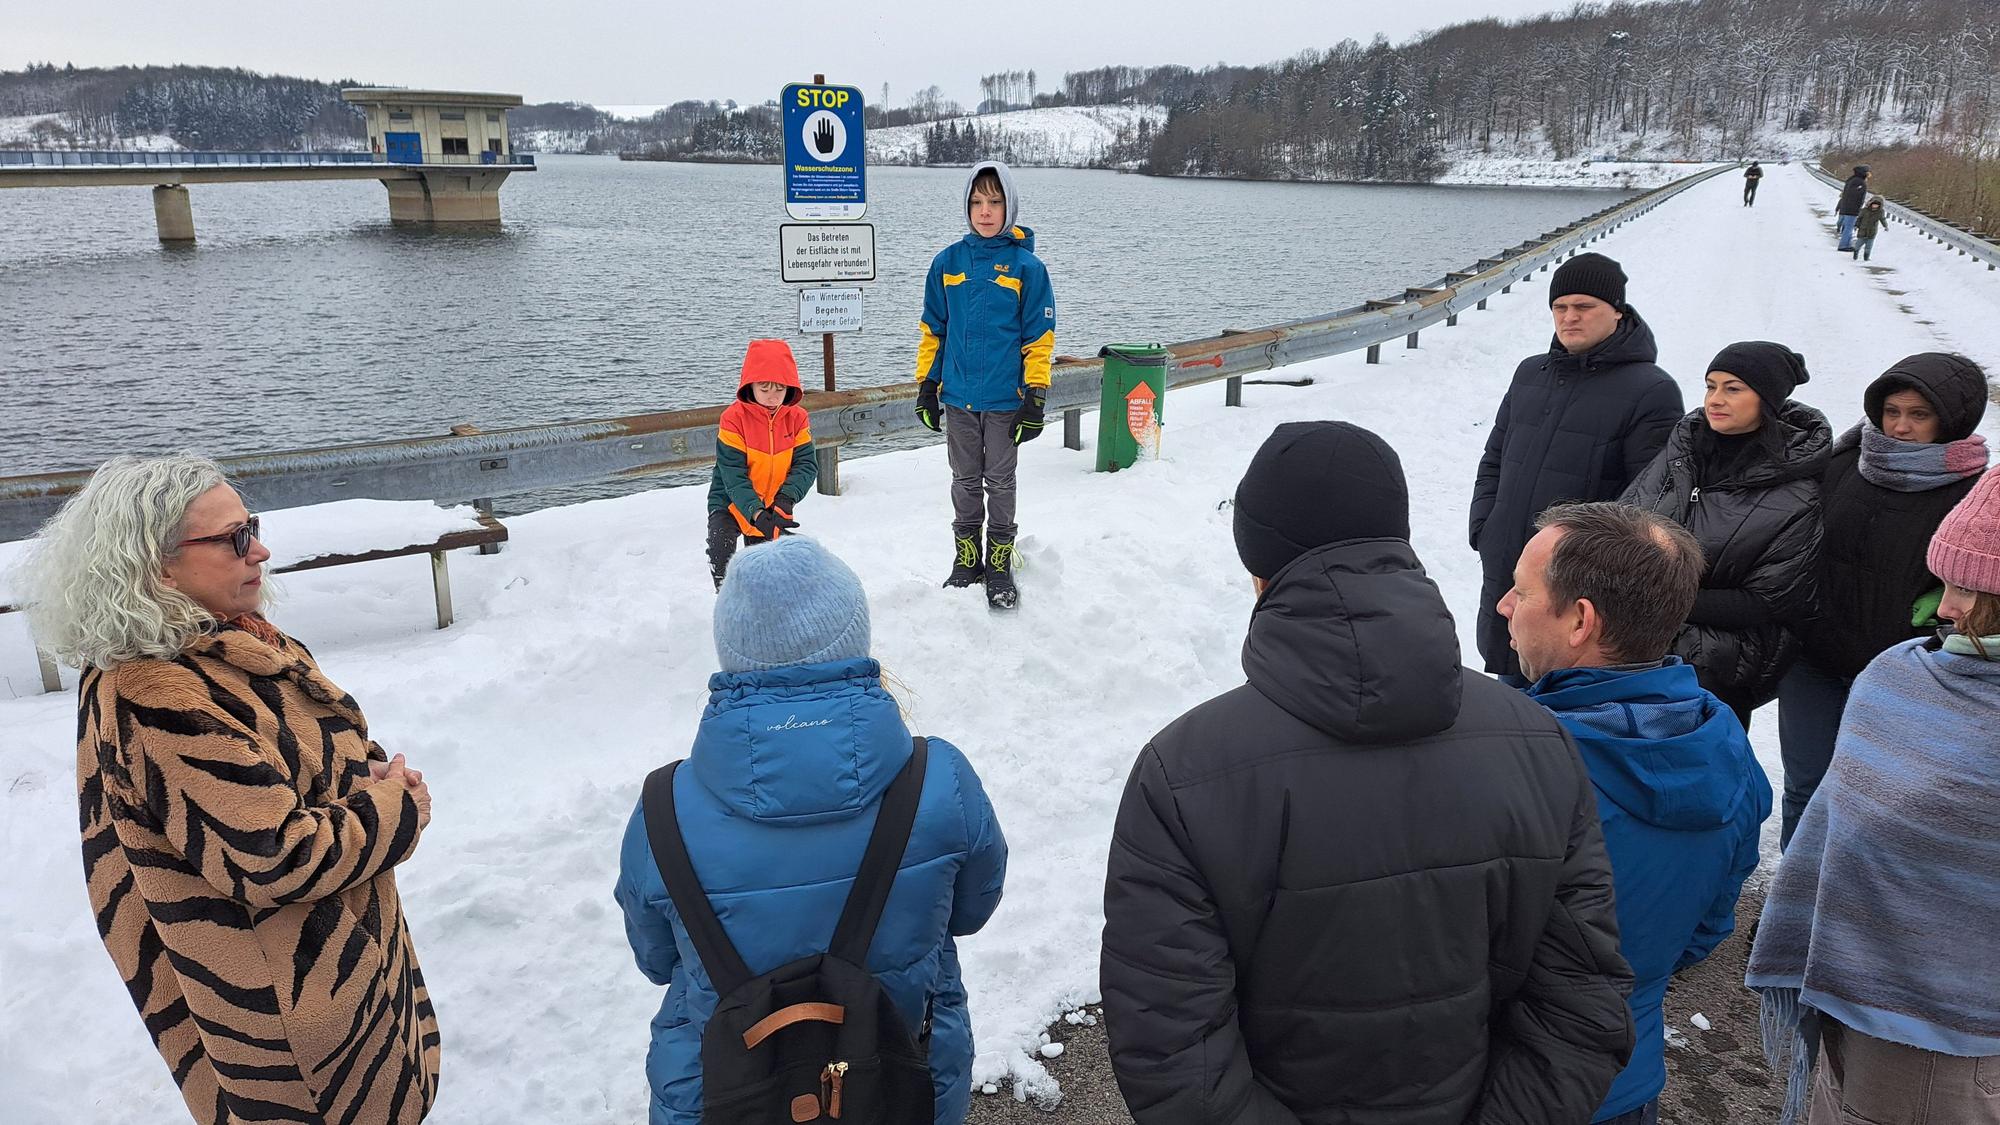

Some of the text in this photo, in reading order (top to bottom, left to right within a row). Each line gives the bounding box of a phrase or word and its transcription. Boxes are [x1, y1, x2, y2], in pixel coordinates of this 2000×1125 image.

[797, 88, 849, 108] STOP
[795, 164, 853, 173] Wasserschutzzone
[807, 232, 849, 242] Das Betreten
[796, 245, 861, 255] der Eisfläche ist mit
[788, 258, 870, 270] Lebensgefahr verbunden!
[802, 292, 861, 302] Kein Winterdienst
[815, 306, 848, 316] Begehen
[802, 316, 860, 329] auf eigene Gefahr
[766, 714, 834, 731] volcano
